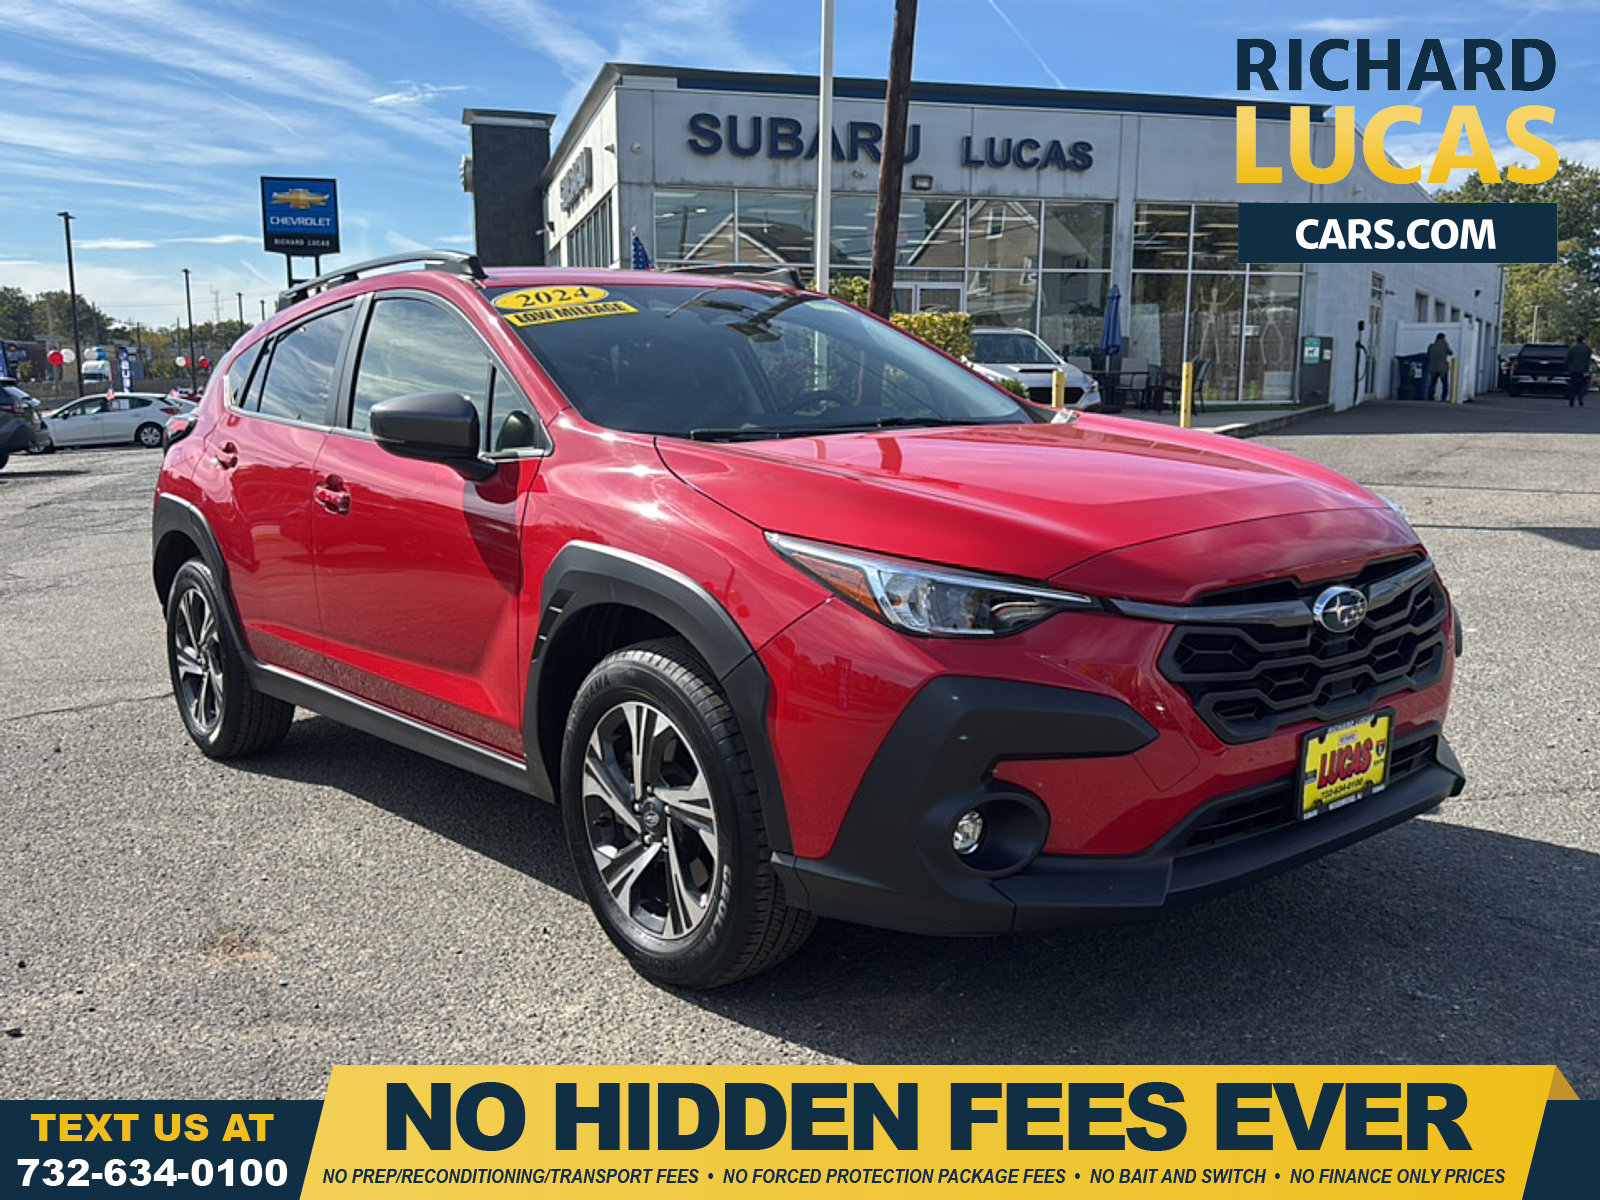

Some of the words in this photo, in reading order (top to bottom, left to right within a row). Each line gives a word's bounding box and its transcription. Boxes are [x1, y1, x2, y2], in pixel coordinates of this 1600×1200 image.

[960, 135, 1093, 171] LUCAS
[270, 215, 331, 227] CHEVROLET
[516, 286, 589, 307] 2024
[514, 310, 556, 324] LOW
[555, 303, 629, 319] MILEAGE
[1317, 738, 1373, 789] LUCAS
